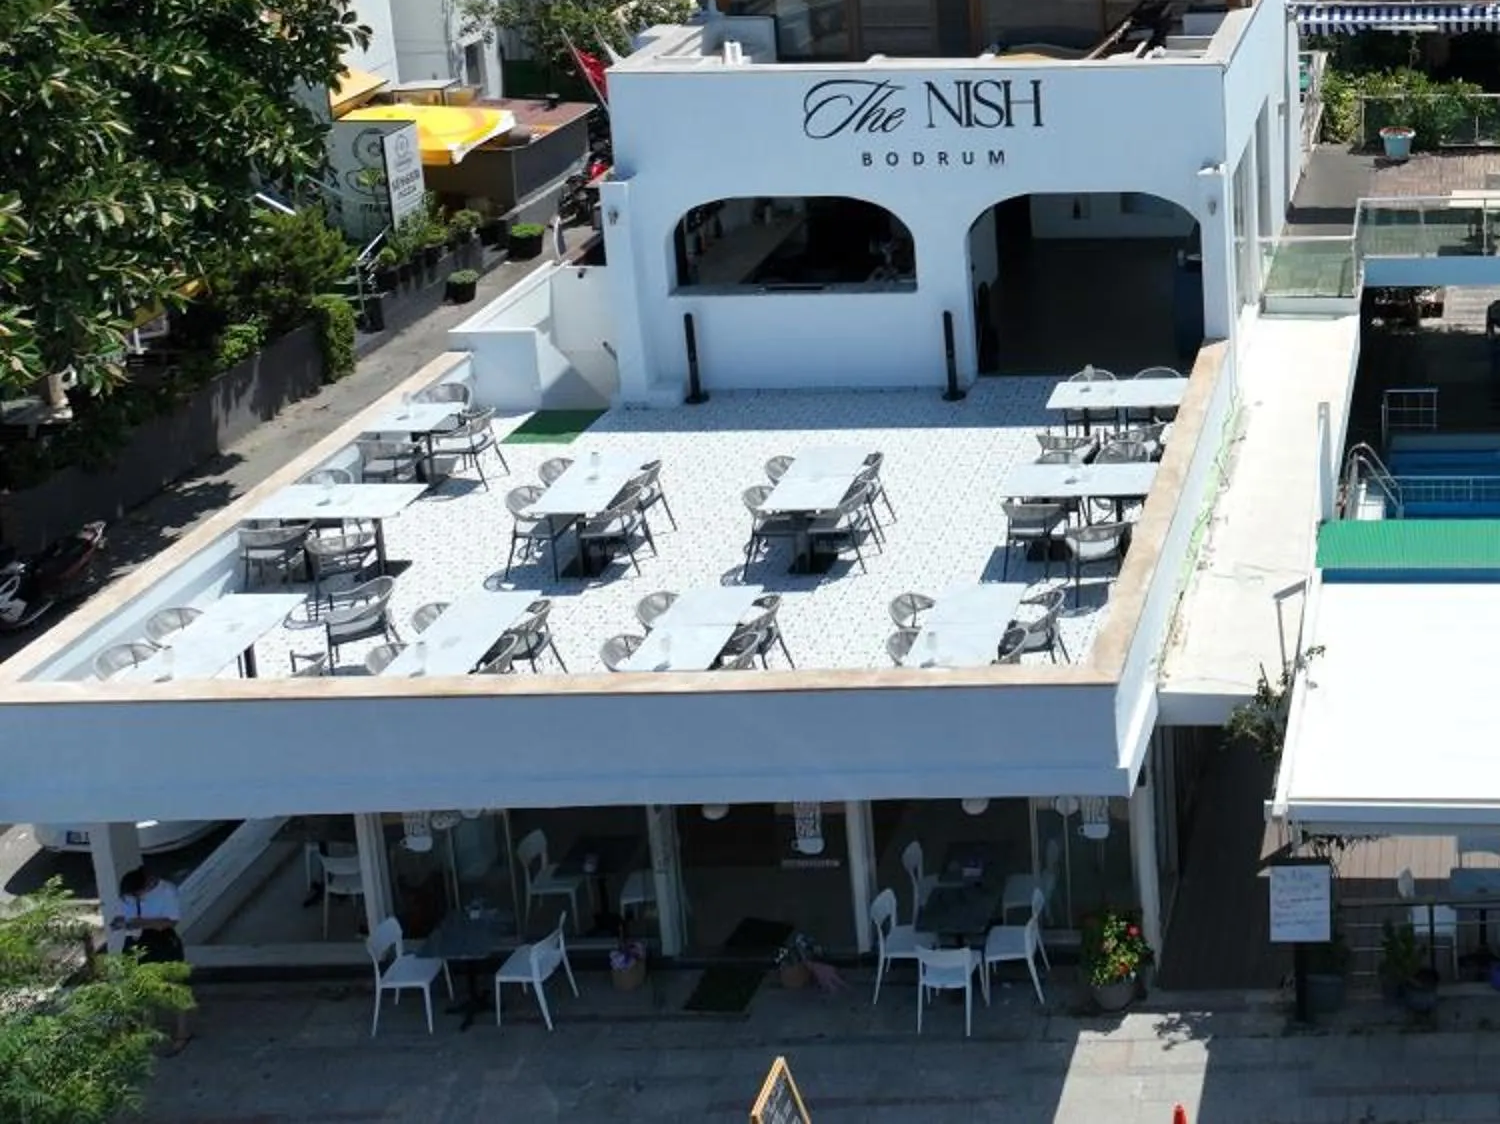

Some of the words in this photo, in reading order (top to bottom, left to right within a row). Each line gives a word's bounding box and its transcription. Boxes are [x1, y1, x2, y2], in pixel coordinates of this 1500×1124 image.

[803, 78, 905, 140] The
[923, 79, 1044, 129] NISH
[862, 149, 1006, 167] BODRUM
